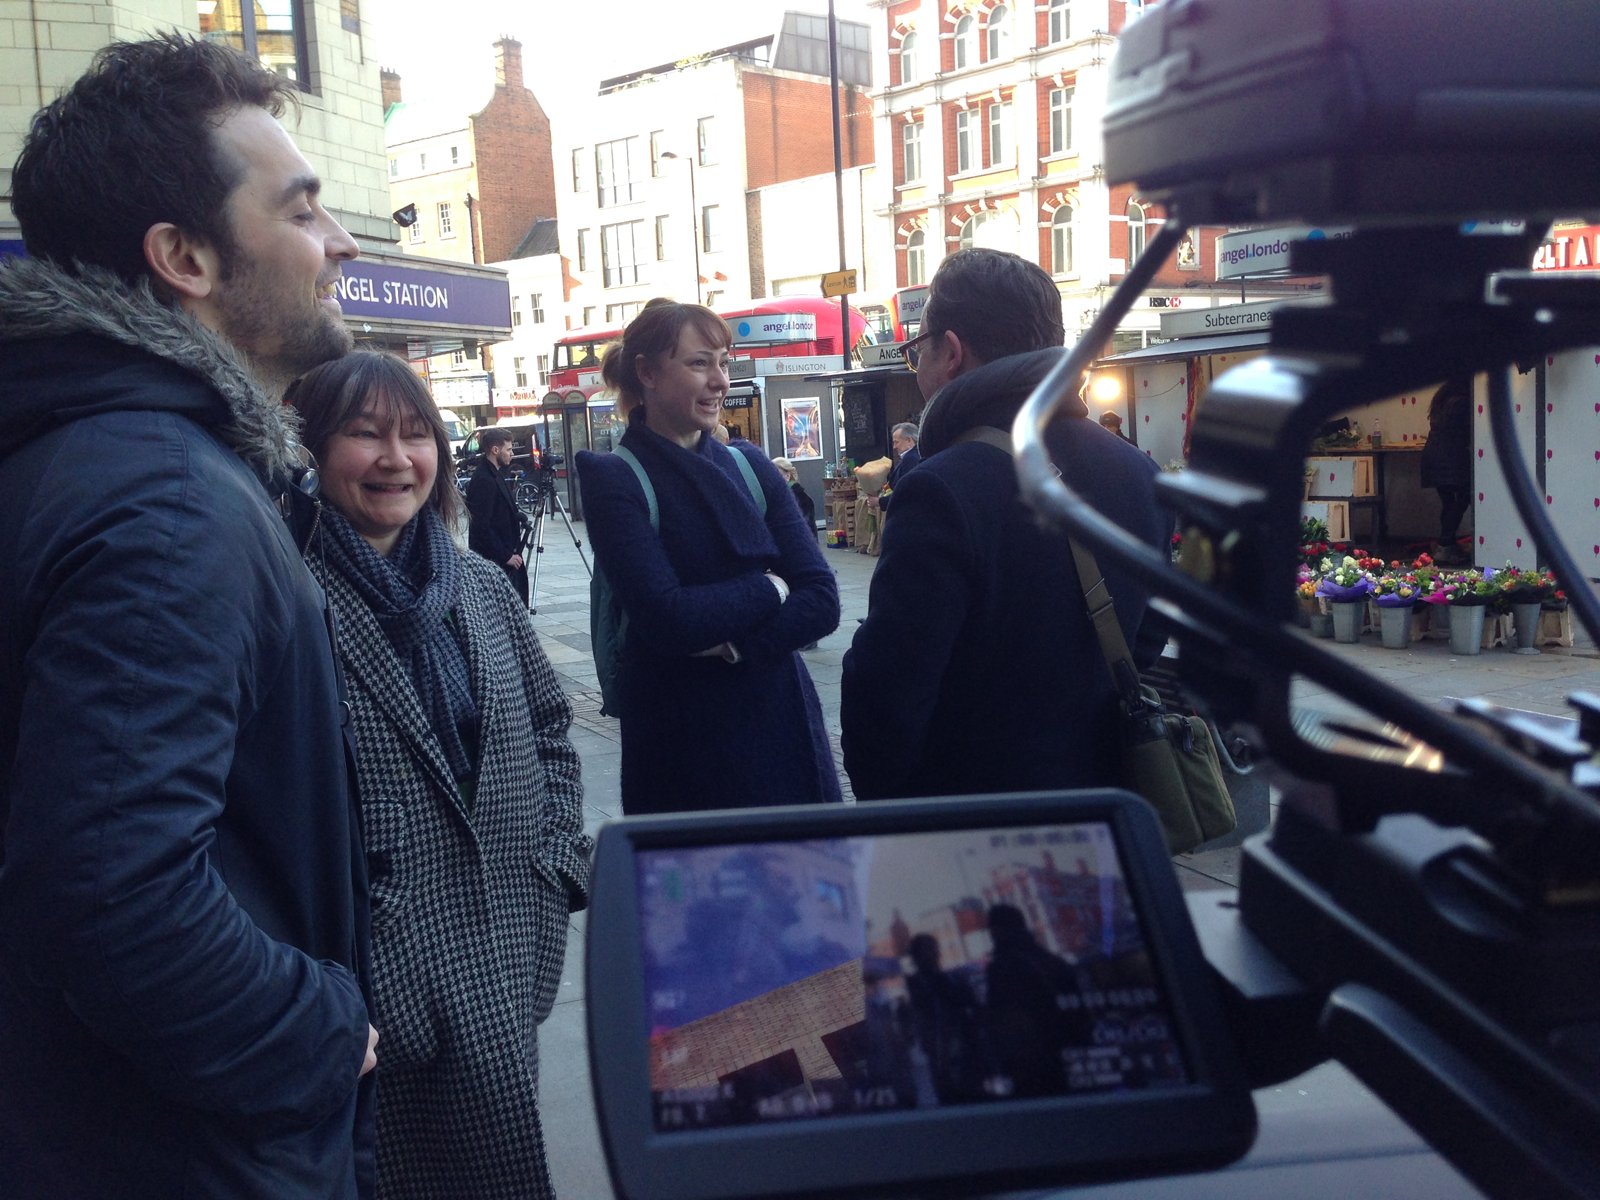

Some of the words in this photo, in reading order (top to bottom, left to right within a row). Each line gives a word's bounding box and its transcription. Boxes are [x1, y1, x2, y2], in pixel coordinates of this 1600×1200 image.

[1220, 239, 1291, 264] angel.londo
[333, 275, 380, 303] NGEL
[383, 280, 449, 309] STATION
[1149, 297, 1170, 307] HSBC
[879, 348, 905, 360] ANGE
[785, 363, 826, 373] ISLINGTON
[724, 397, 747, 407] COFFEE
